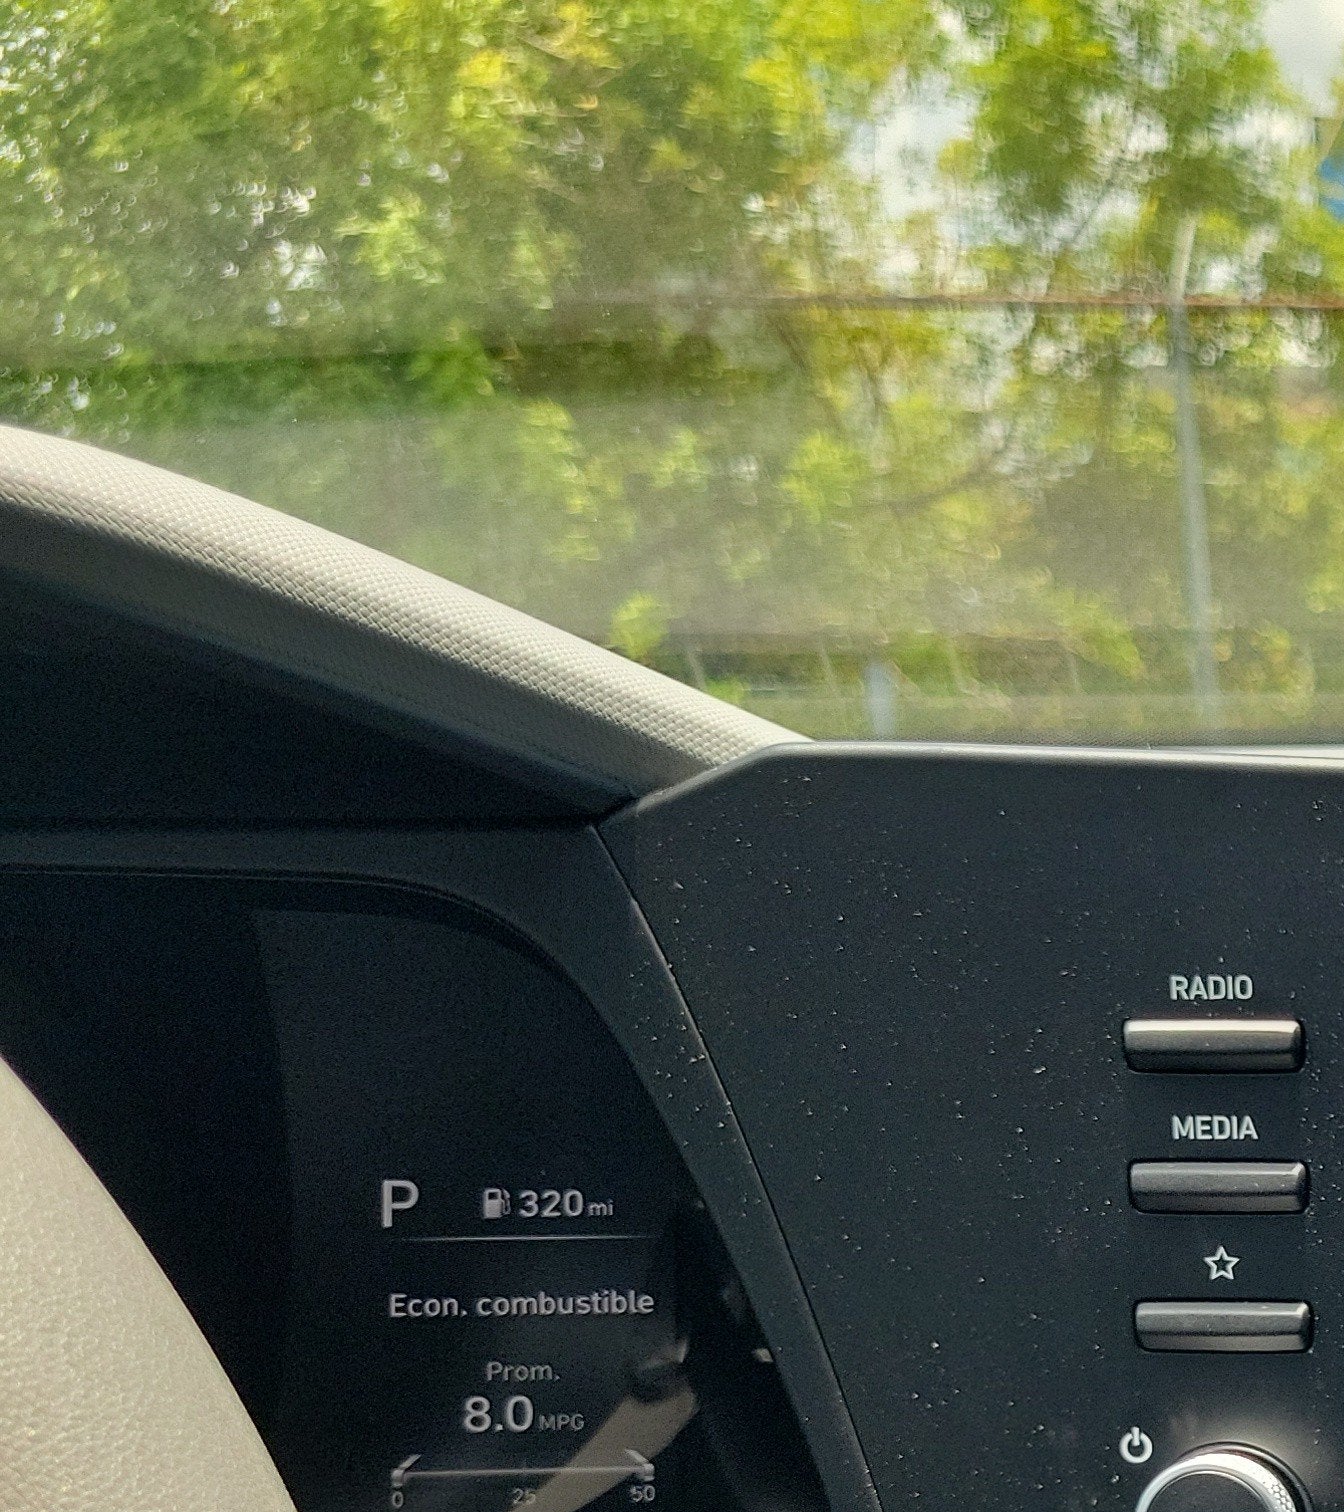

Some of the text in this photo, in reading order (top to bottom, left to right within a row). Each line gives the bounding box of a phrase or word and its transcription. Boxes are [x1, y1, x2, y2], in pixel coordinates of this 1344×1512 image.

[1168, 974, 1255, 1002] RADIO
[1171, 1115, 1259, 1142] MEDIA
[381, 1179, 420, 1228] P
[518, 1189, 584, 1218] 320
[388, 1289, 655, 1318] Econ. combustible
[486, 1361, 561, 1382] Prom.
[463, 1395, 585, 1433] 8.0 MPG
[391, 1491, 404, 1509] 0
[630, 1485, 656, 1503] 50
